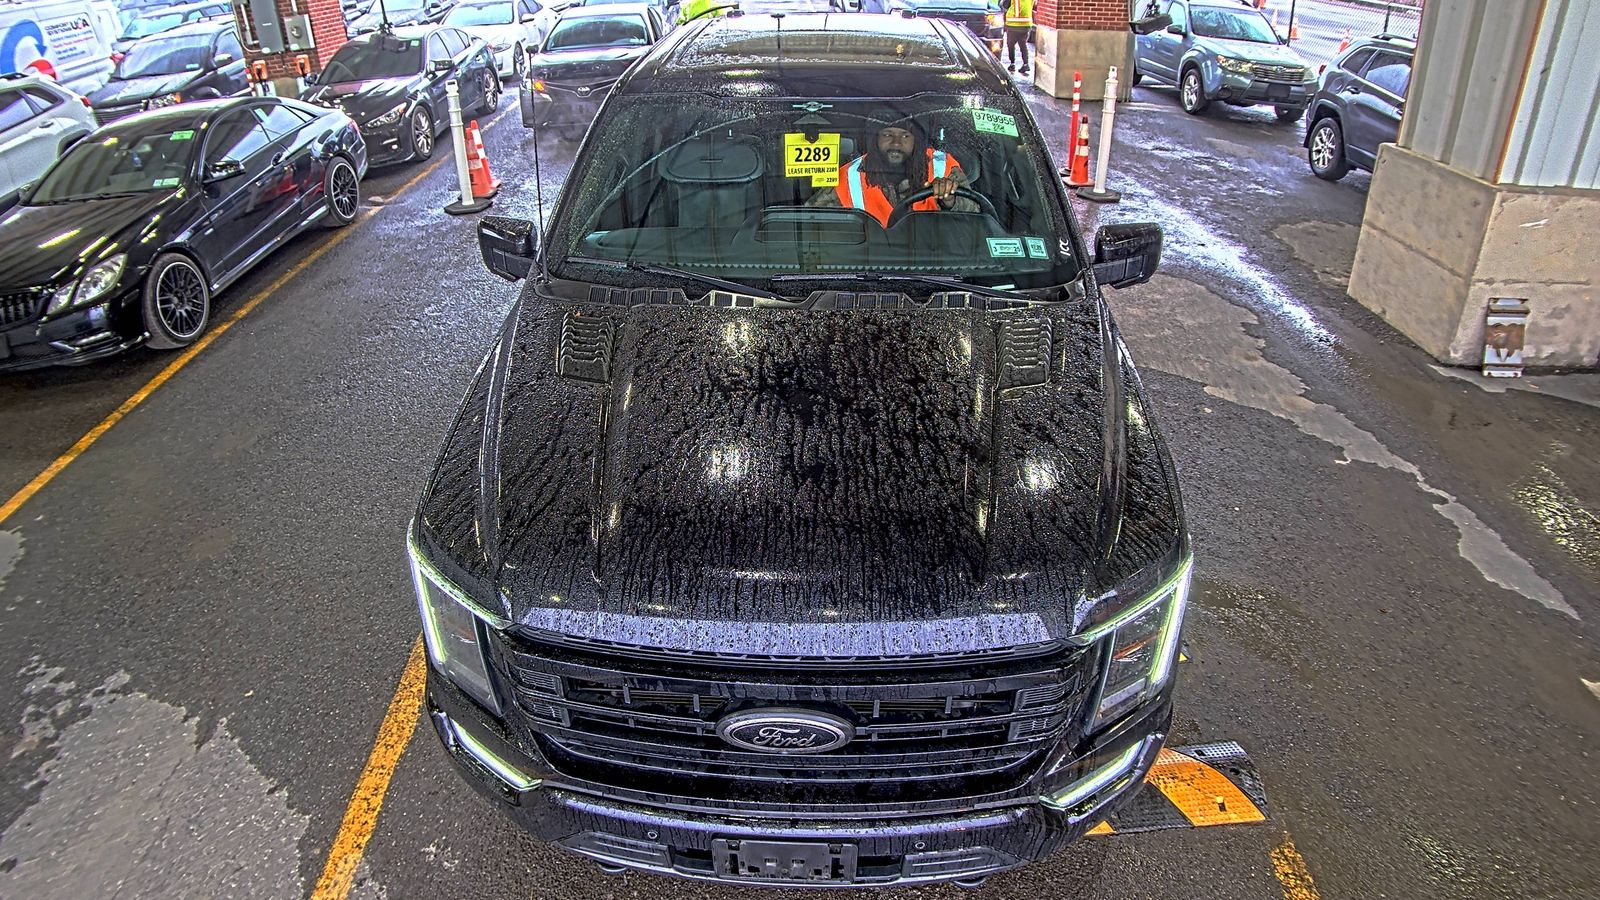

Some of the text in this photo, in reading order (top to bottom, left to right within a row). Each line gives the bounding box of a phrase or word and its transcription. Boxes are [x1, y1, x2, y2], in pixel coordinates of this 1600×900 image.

[974, 112, 1015, 126] 9789955
[794, 147, 830, 162] 2289
[804, 166, 825, 174] RETURN
[753, 726, 816, 748] Ford
